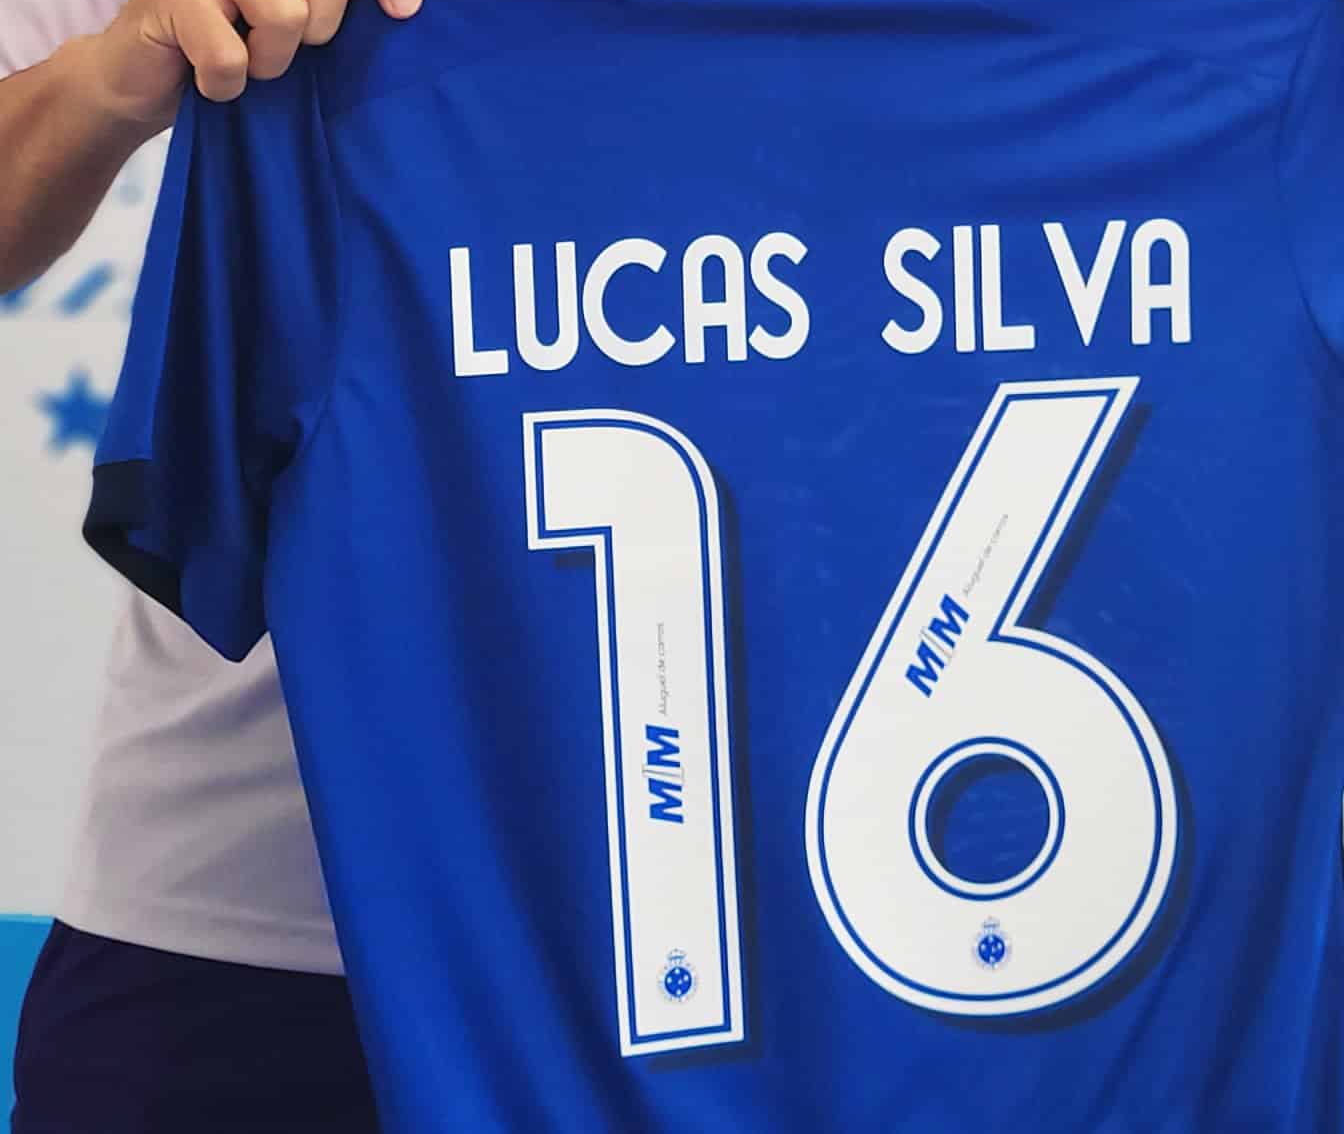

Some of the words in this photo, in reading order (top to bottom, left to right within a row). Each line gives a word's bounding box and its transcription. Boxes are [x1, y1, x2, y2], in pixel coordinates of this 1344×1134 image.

[449, 232, 810, 377] LUCAS
[881, 218, 1191, 354] SILVA
[522, 375, 1178, 1057] 16
